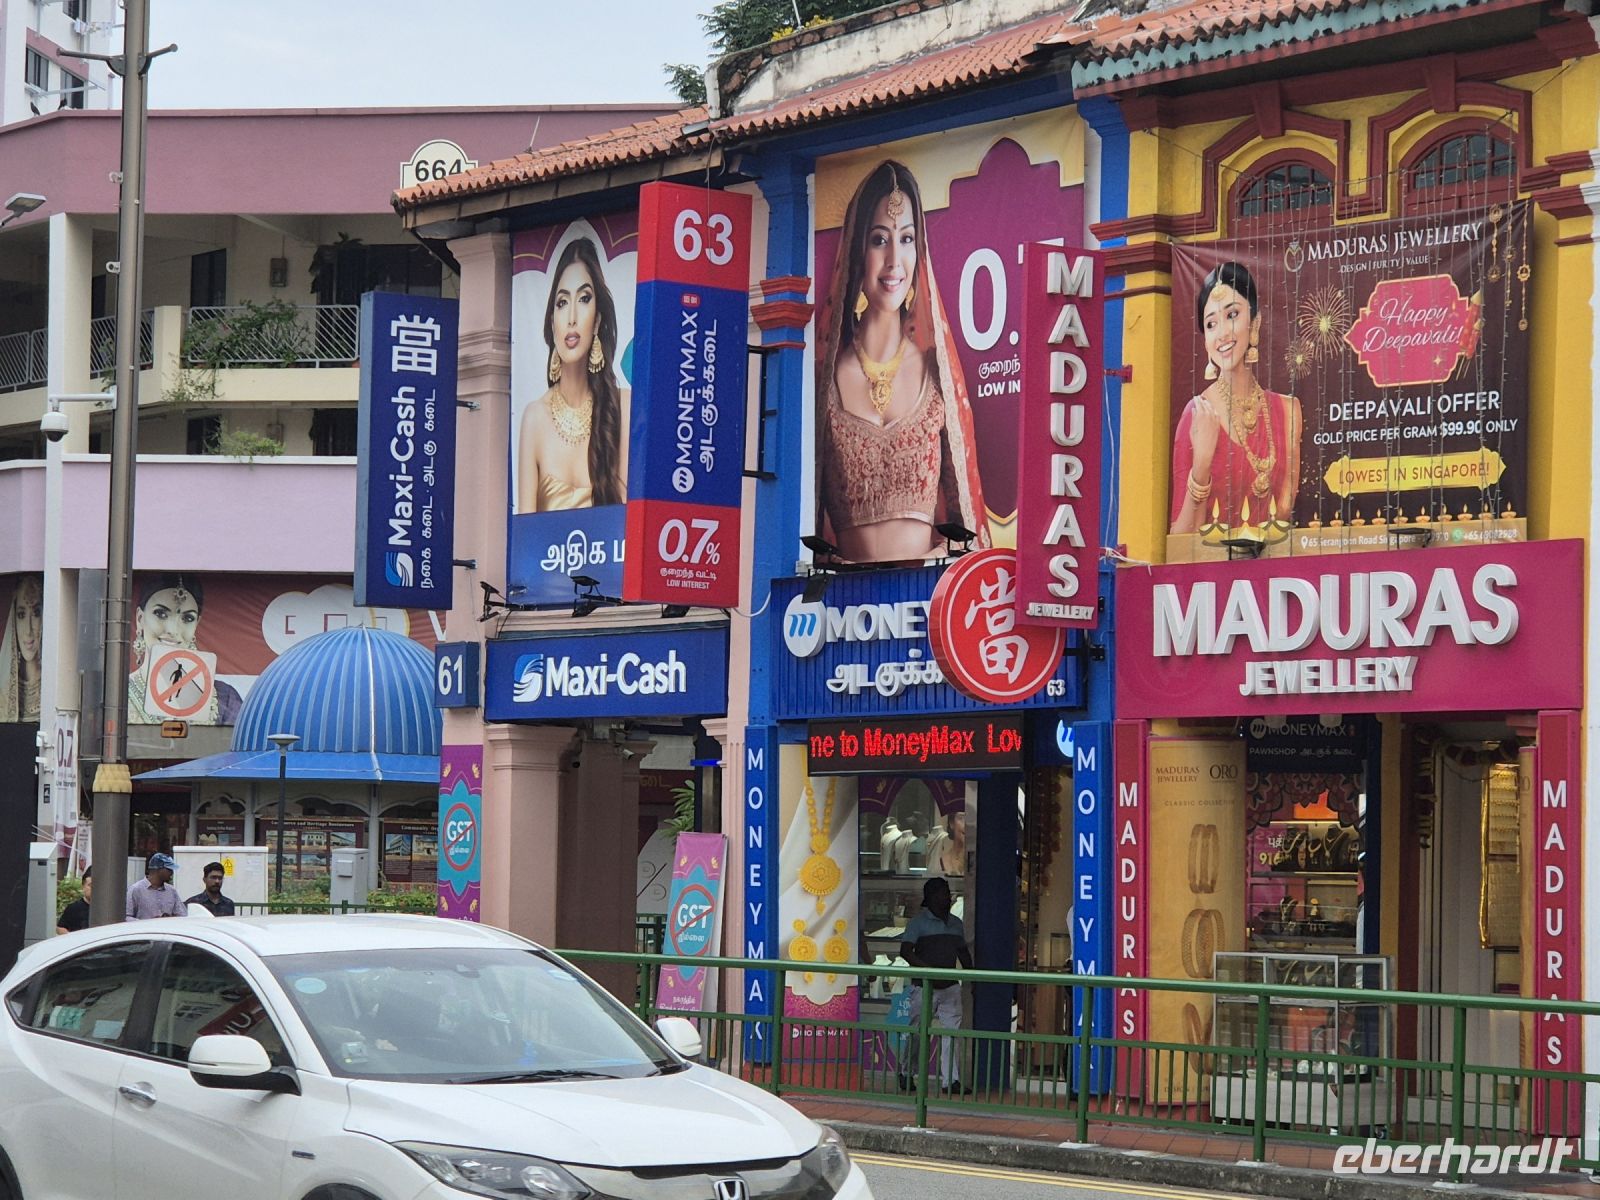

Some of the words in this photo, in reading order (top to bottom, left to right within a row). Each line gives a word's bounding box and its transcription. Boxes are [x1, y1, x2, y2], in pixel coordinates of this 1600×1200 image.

[415, 159, 462, 182] 664
[673, 209, 734, 265] 63
[1308, 233, 1388, 261] MADURAS
[1394, 222, 1482, 252] JEWELLERY
[1405, 255, 1429, 265] VALUE
[1379, 295, 1449, 328] Happy
[1363, 325, 1463, 352] Deepavali!
[676, 310, 699, 465] MONEYMAX
[978, 380, 1005, 398] LOW
[424, 389, 436, 432] கடை
[1329, 396, 1432, 422] DEEPAVALI
[1437, 391, 1501, 414] OFFER
[1042, 252, 1094, 598] MADURAS
[1313, 431, 1344, 445] GOLD
[1346, 428, 1378, 443] PRICE
[1380, 428, 1400, 441] PER
[1403, 425, 1438, 439] GRAM
[1441, 419, 1481, 438] $99.90
[1485, 418, 1519, 434] ONLY
[388, 386, 416, 546] Maxi-Cash
[423, 440, 437, 487] அடகு
[1338, 468, 1389, 485] LOWEST
[1393, 467, 1407, 481] IN
[1412, 462, 1490, 480] SINGAPORE!
[421, 496, 433, 539] கடை
[540, 529, 606, 577] அதிக
[658, 518, 721, 566] 0.7%
[421, 547, 435, 589] நகை
[666, 579, 682, 588] LOW
[681, 580, 710, 589] INTEREST
[1026, 602, 1095, 620] JEWELLERY
[1152, 563, 1519, 657] MADURAS
[438, 654, 464, 696] 61
[545, 649, 687, 698] Maxi-Cash
[1047, 679, 1066, 697] 63
[1239, 656, 1419, 697] JEWELLERY
[840, 730, 859, 757] to
[864, 725, 975, 762] MoneyMax
[1267, 723, 1347, 737] MONEYMAX
[1249, 747, 1297, 756] PAWNSHOP
[1155, 765, 1201, 775] MADURAS
[1157, 775, 1199, 784] JEWELLERY
[1209, 764, 1239, 780] ORO
[447, 820, 473, 843] GST
[677, 902, 712, 929] GST
[1119, 781, 1138, 1036] MADURAS
[1543, 779, 1568, 1065] MADURAS
